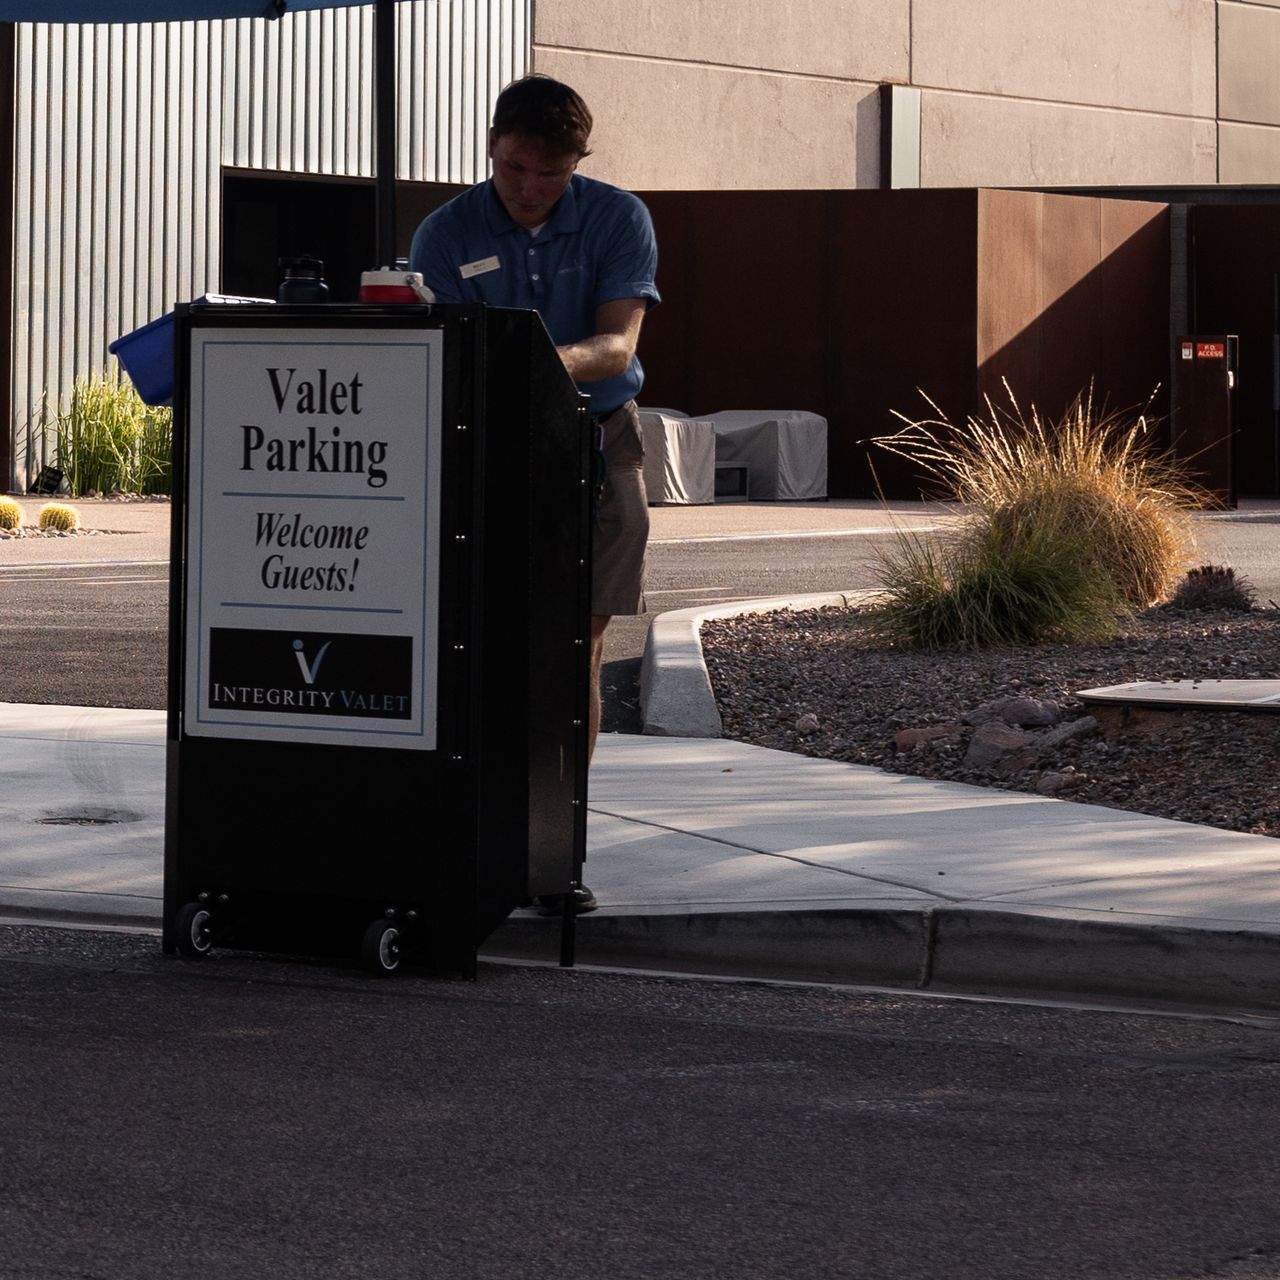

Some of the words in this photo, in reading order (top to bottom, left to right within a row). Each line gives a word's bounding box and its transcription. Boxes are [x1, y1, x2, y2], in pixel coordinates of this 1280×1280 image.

[265, 367, 363, 415] Valet
[240, 425, 388, 488] Parking
[255, 512, 369, 550] Welcome
[261, 554, 359, 592] Guests!
[213, 683, 334, 708] INTEGRITY
[340, 690, 408, 712] VALET
